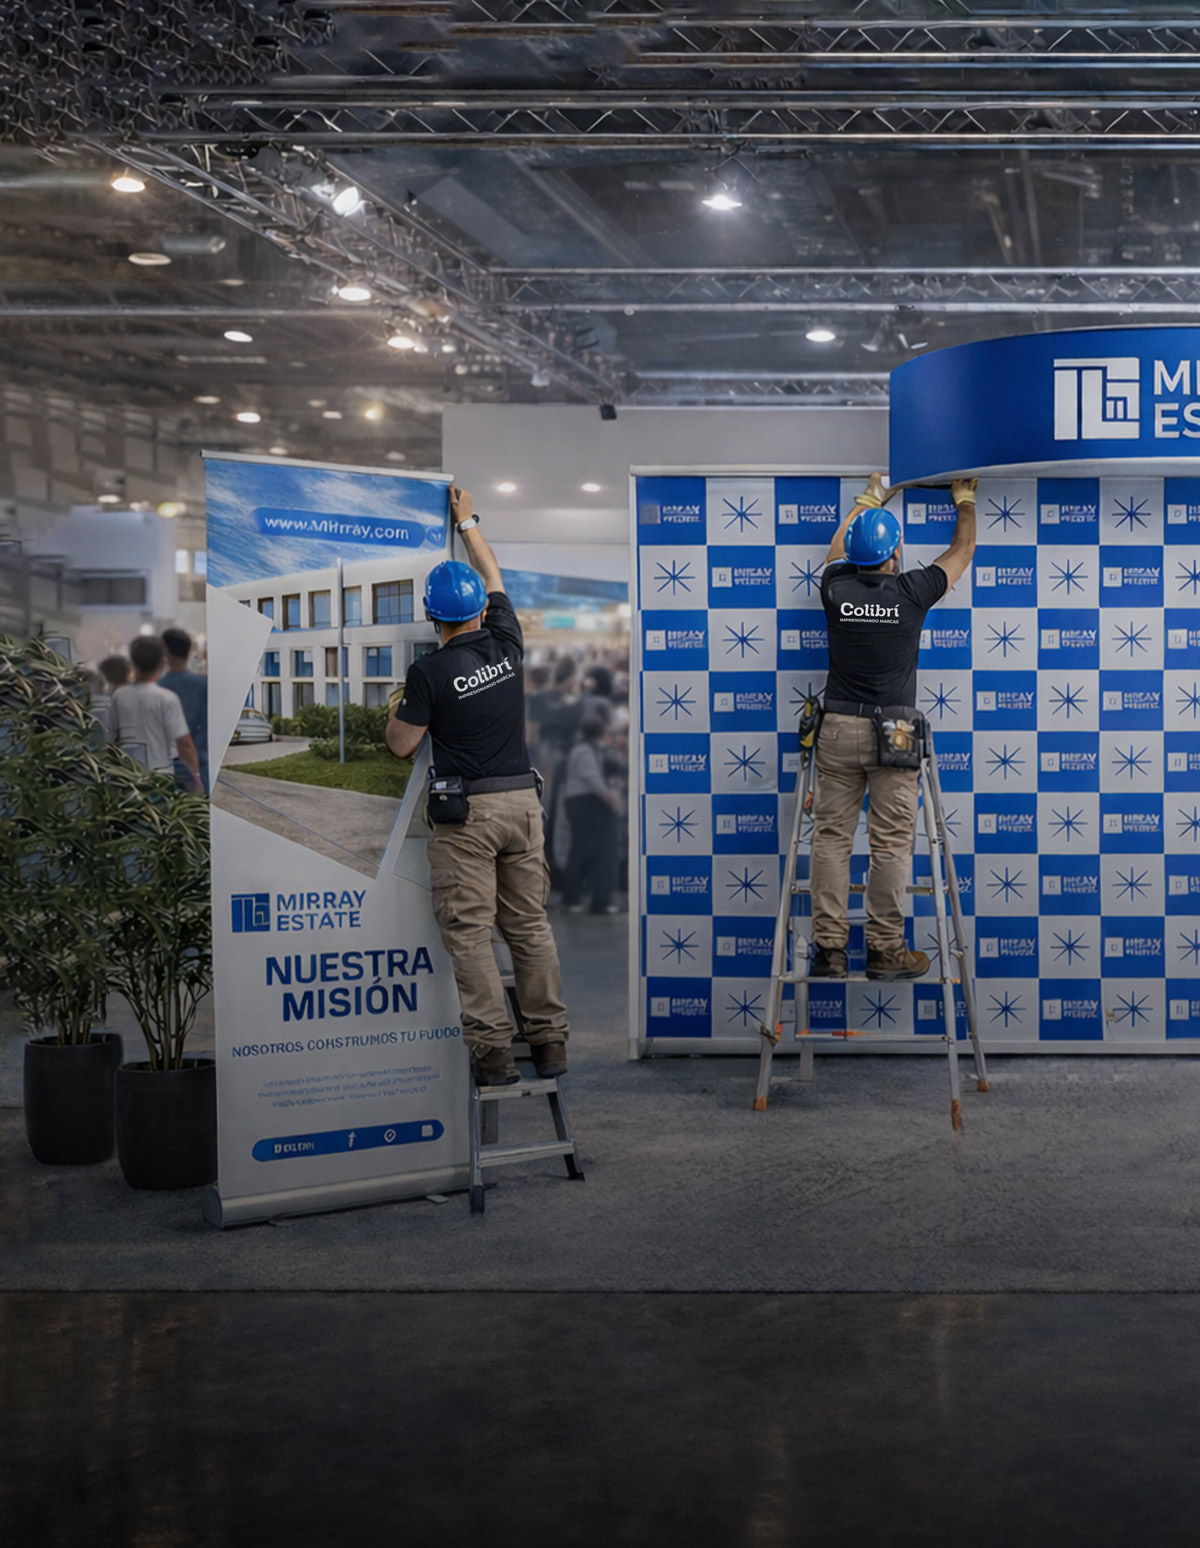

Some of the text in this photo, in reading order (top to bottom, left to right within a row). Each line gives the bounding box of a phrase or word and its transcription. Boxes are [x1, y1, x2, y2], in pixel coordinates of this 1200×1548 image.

[840, 602, 900, 617] Colibrí
[453, 656, 513, 693] Colibrí
[277, 889, 367, 912] MIRRAY
[277, 910, 361, 932] ESTATE
[265, 946, 434, 986] NUESTRA
[282, 977, 418, 1022] MISIÓN
[232, 1041, 304, 1058] NOSOTROS
[401, 1030, 417, 1043] TU
